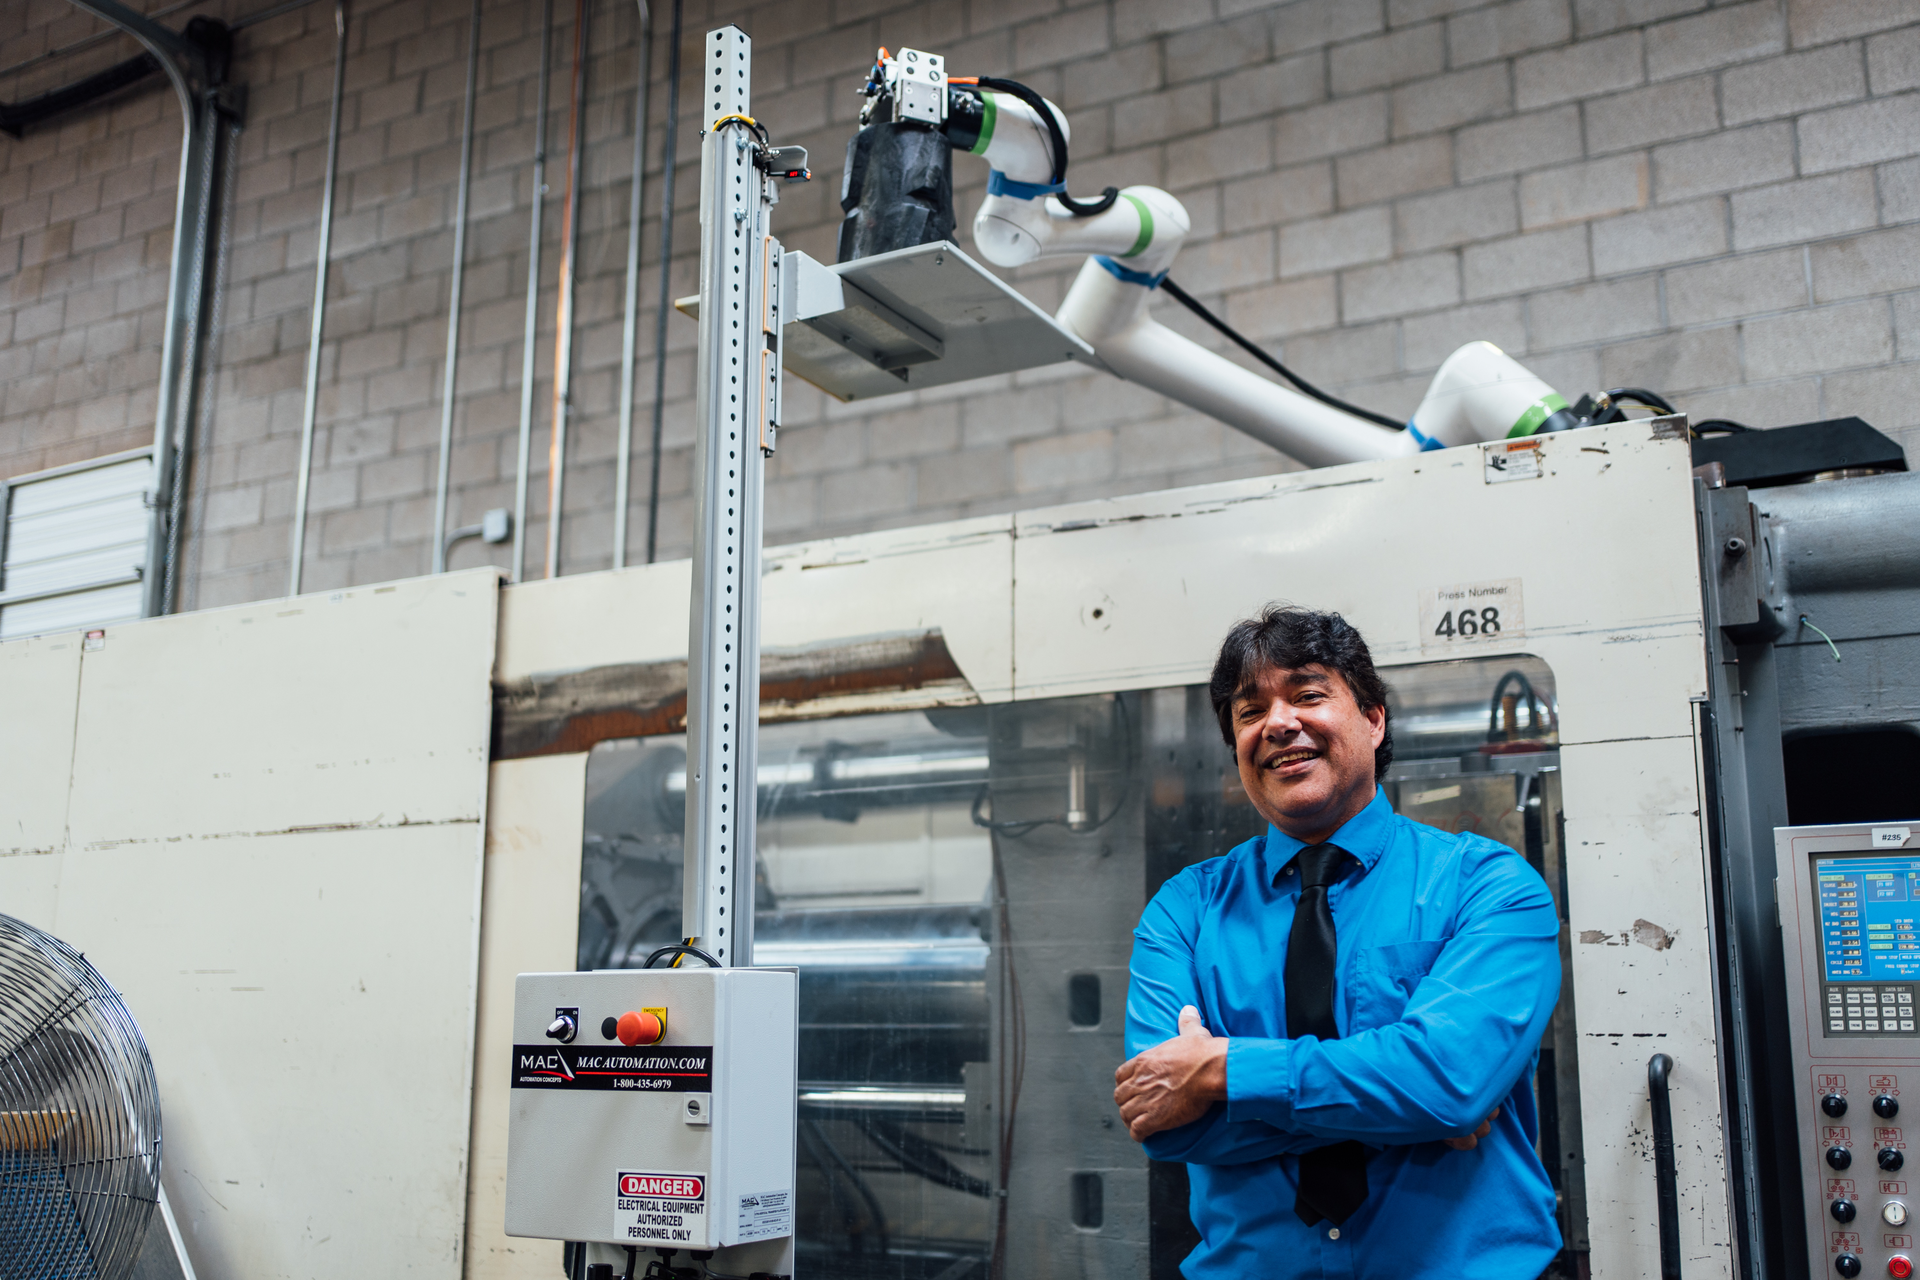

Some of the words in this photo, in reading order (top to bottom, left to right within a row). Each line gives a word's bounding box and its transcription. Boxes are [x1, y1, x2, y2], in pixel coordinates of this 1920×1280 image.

[1438, 591, 1465, 600] Press
[1469, 586, 1508, 598] Number
[1435, 606, 1501, 641] 468
[1881, 833, 1902, 841] #235
[521, 1055, 558, 1069] MAC
[576, 1056, 602, 1069] MAC
[602, 1057, 706, 1070] AUTOMATION.COM
[613, 1078, 672, 1089] 1-800-435-6979
[628, 1177, 694, 1195] DANGER
[618, 1199, 660, 1212] ELECTRICAL
[662, 1201, 704, 1214] EQUIPMENT
[637, 1213, 683, 1227] AUTHORIZED
[628, 1226, 670, 1240] PERSONNEL
[672, 1229, 691, 1241] ONLY
